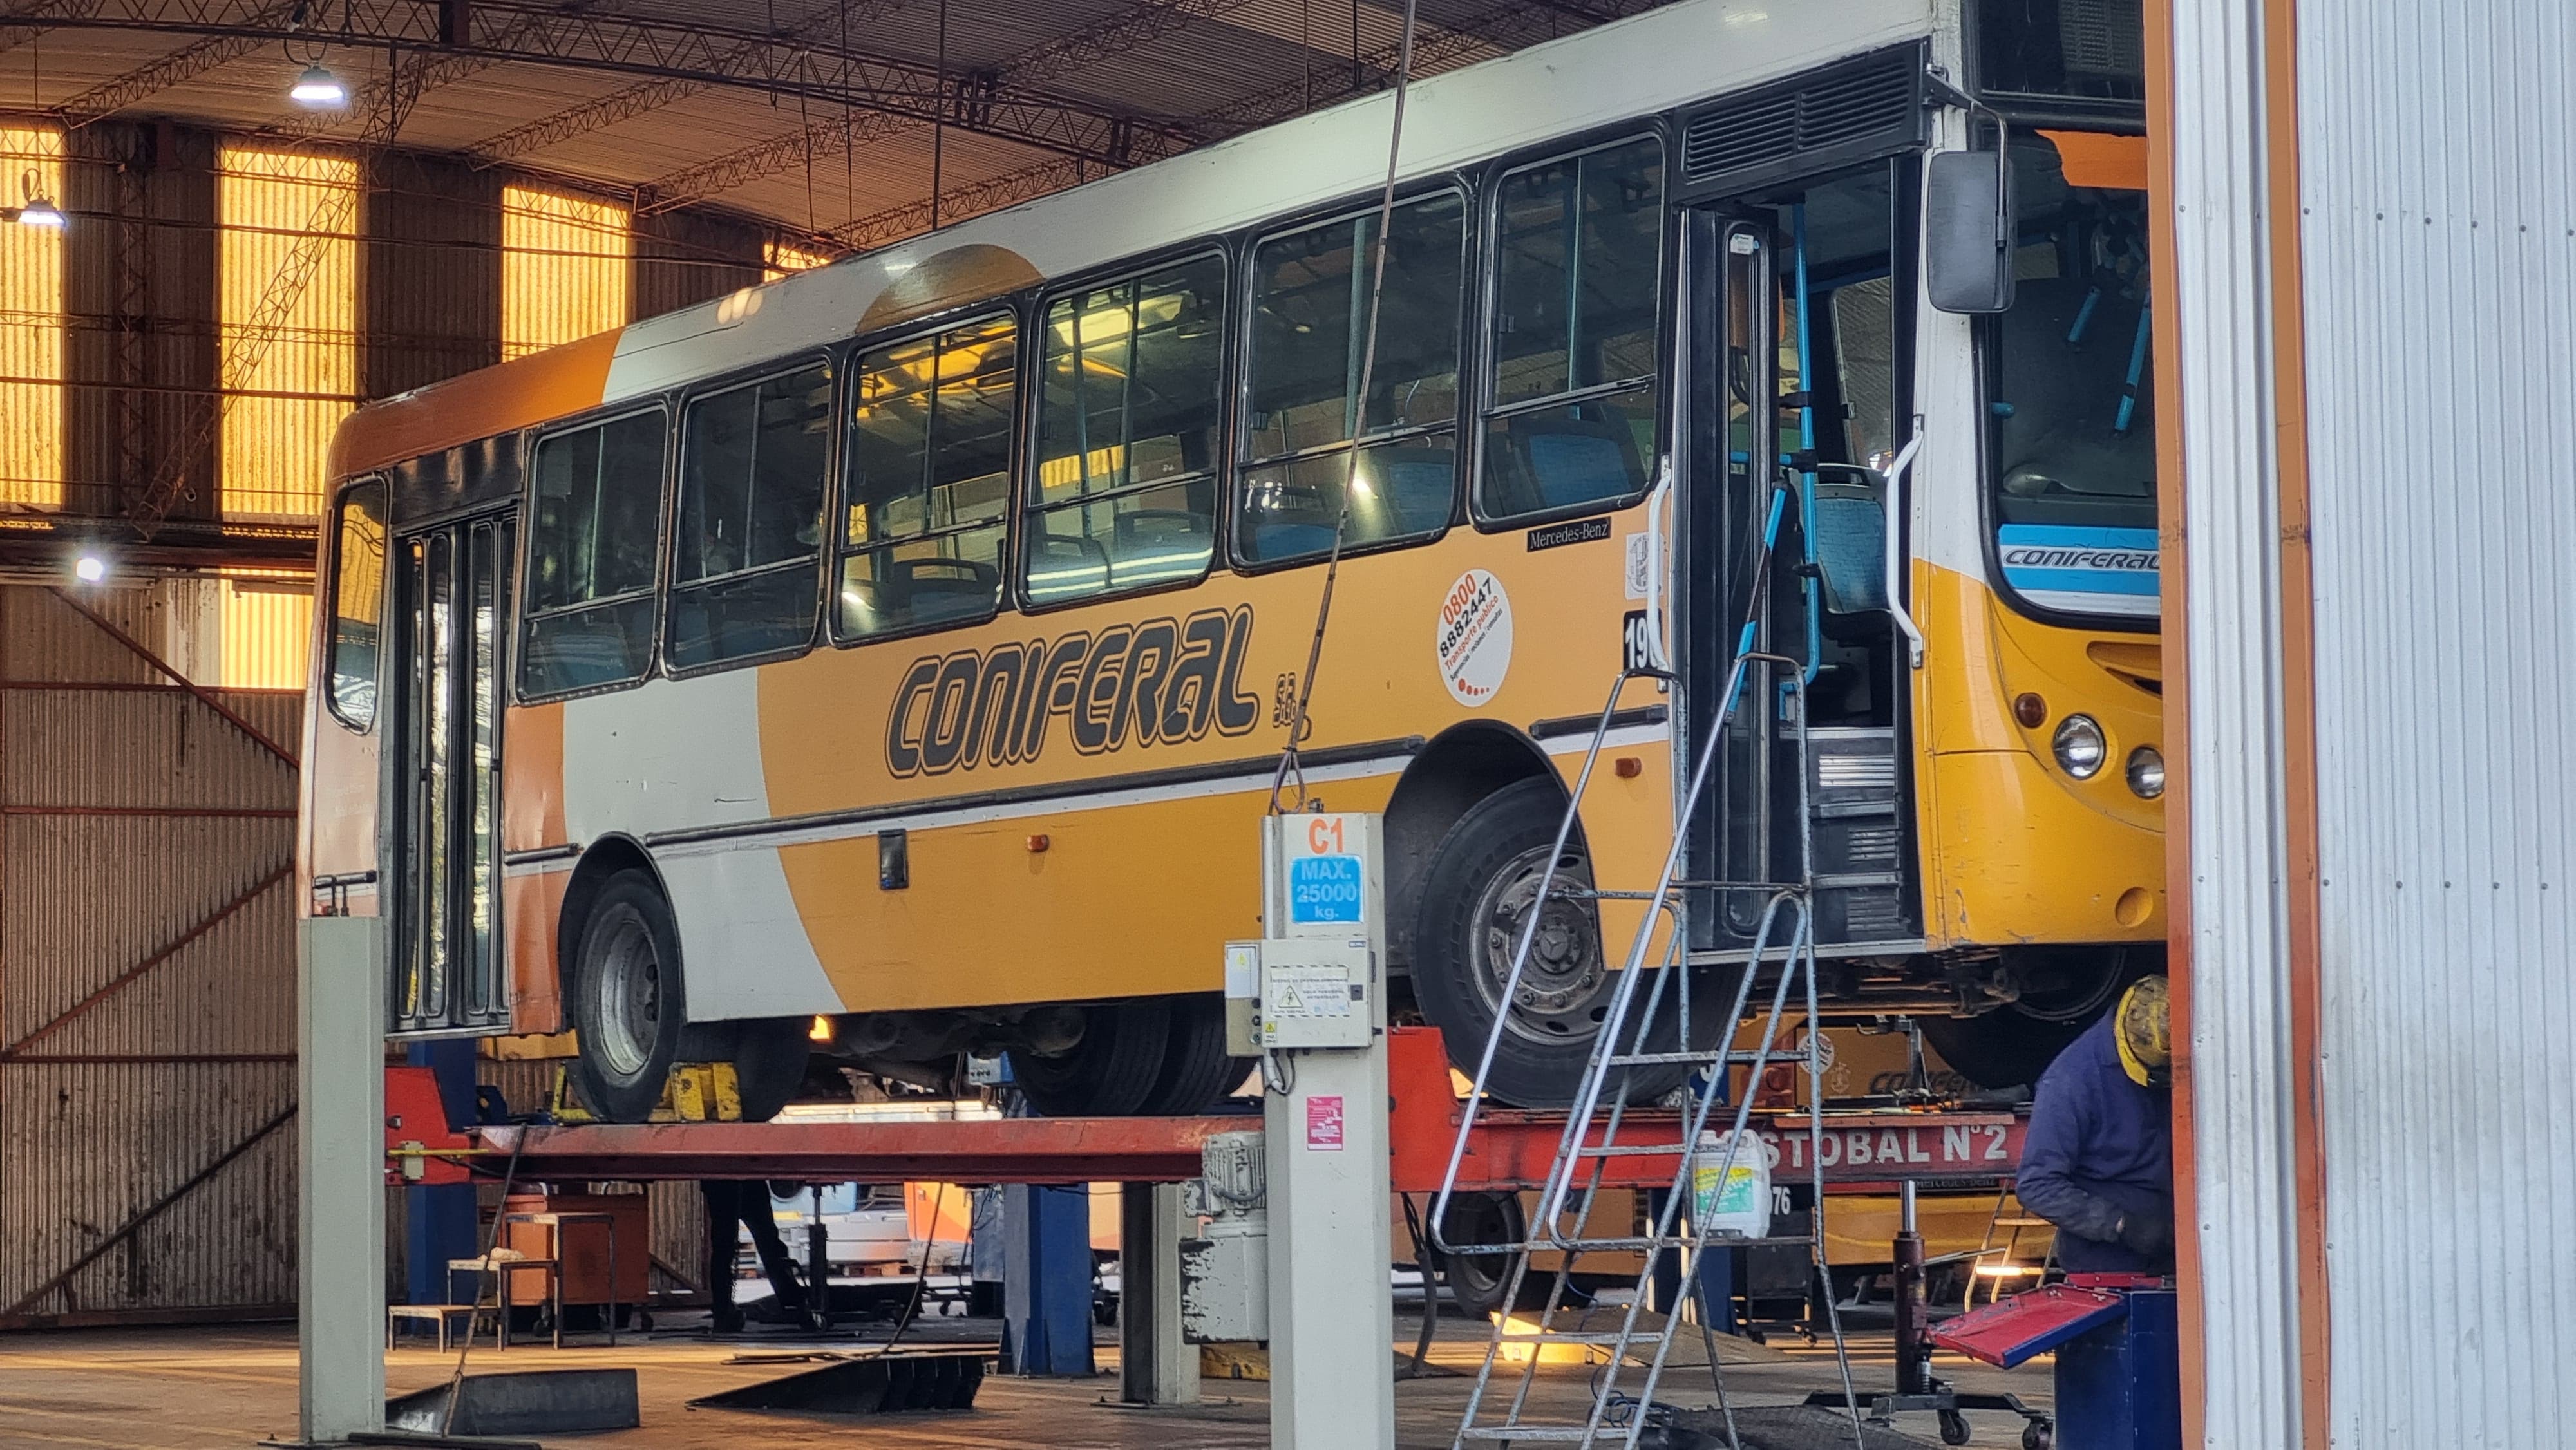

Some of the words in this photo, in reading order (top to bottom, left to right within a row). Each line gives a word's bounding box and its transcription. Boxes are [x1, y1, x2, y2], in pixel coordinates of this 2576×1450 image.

[1530, 518, 1609, 549] Mercedes-Benz
[1443, 573, 1476, 625] 0800
[1440, 576, 1493, 658] 8882447
[1444, 625, 1477, 670] Transporte
[1309, 817, 1343, 854] C1
[1301, 860, 1352, 880] MAX.
[1297, 883, 1356, 903] 25000
[1314, 905, 1340, 920] kg.
